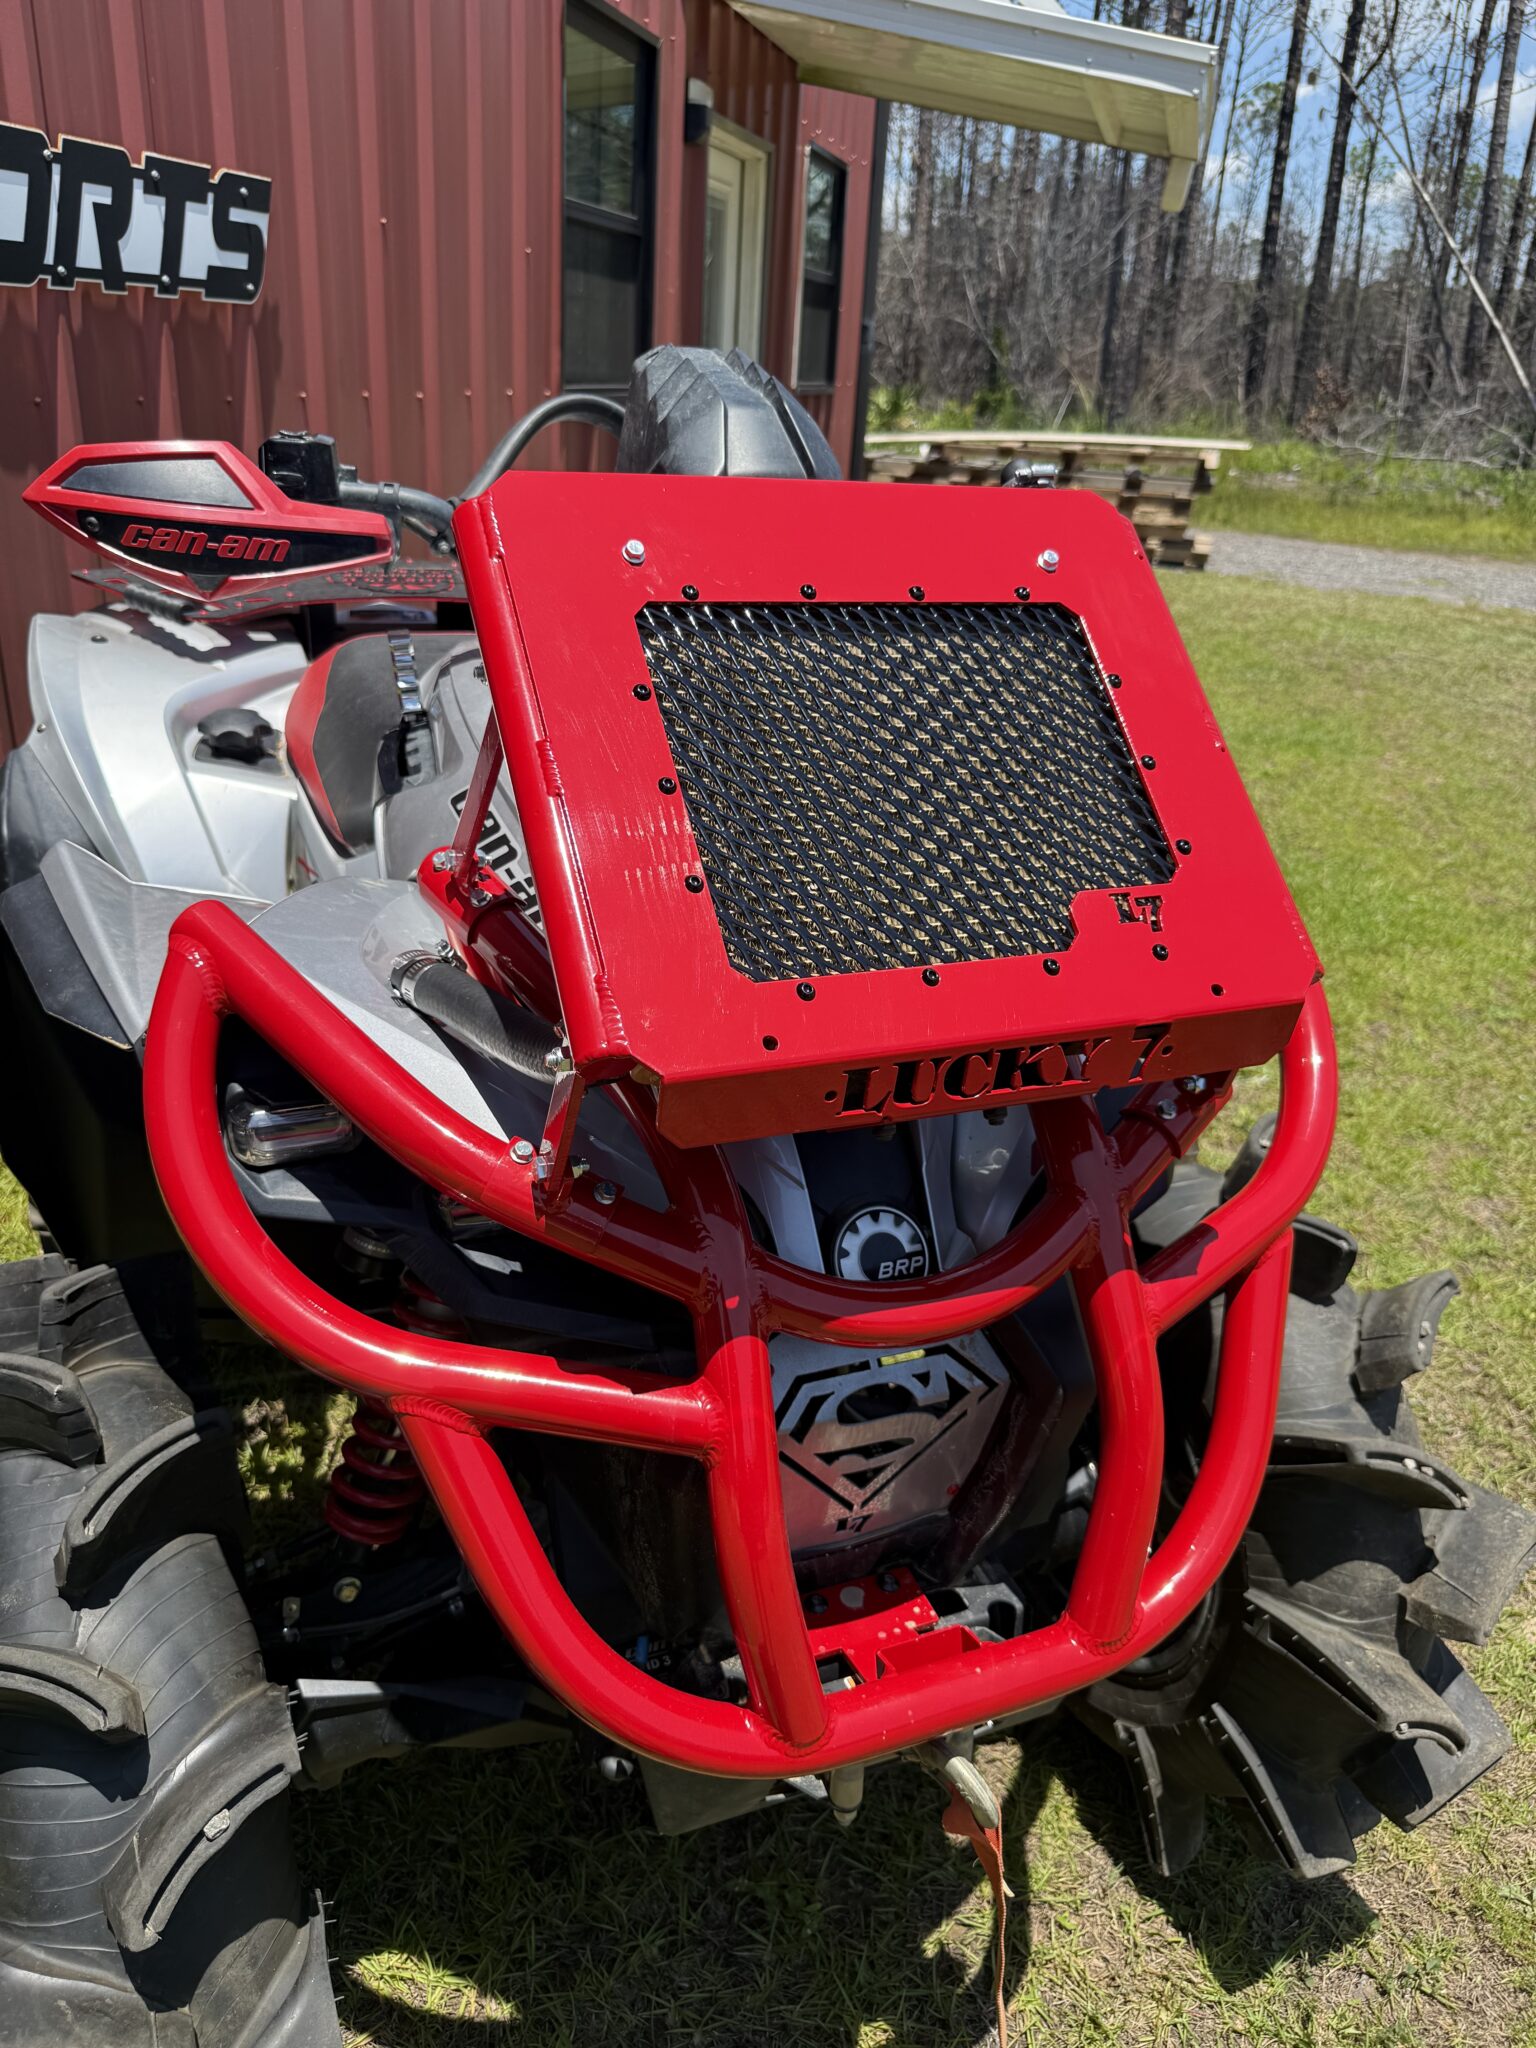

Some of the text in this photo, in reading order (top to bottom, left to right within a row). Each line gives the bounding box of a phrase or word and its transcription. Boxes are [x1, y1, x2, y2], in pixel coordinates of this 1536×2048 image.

[120, 524, 291, 562] can-am
[1108, 892, 1164, 933] L7
[834, 1022, 1171, 1117] LUCKY 7
[878, 1256, 924, 1279] BRP
